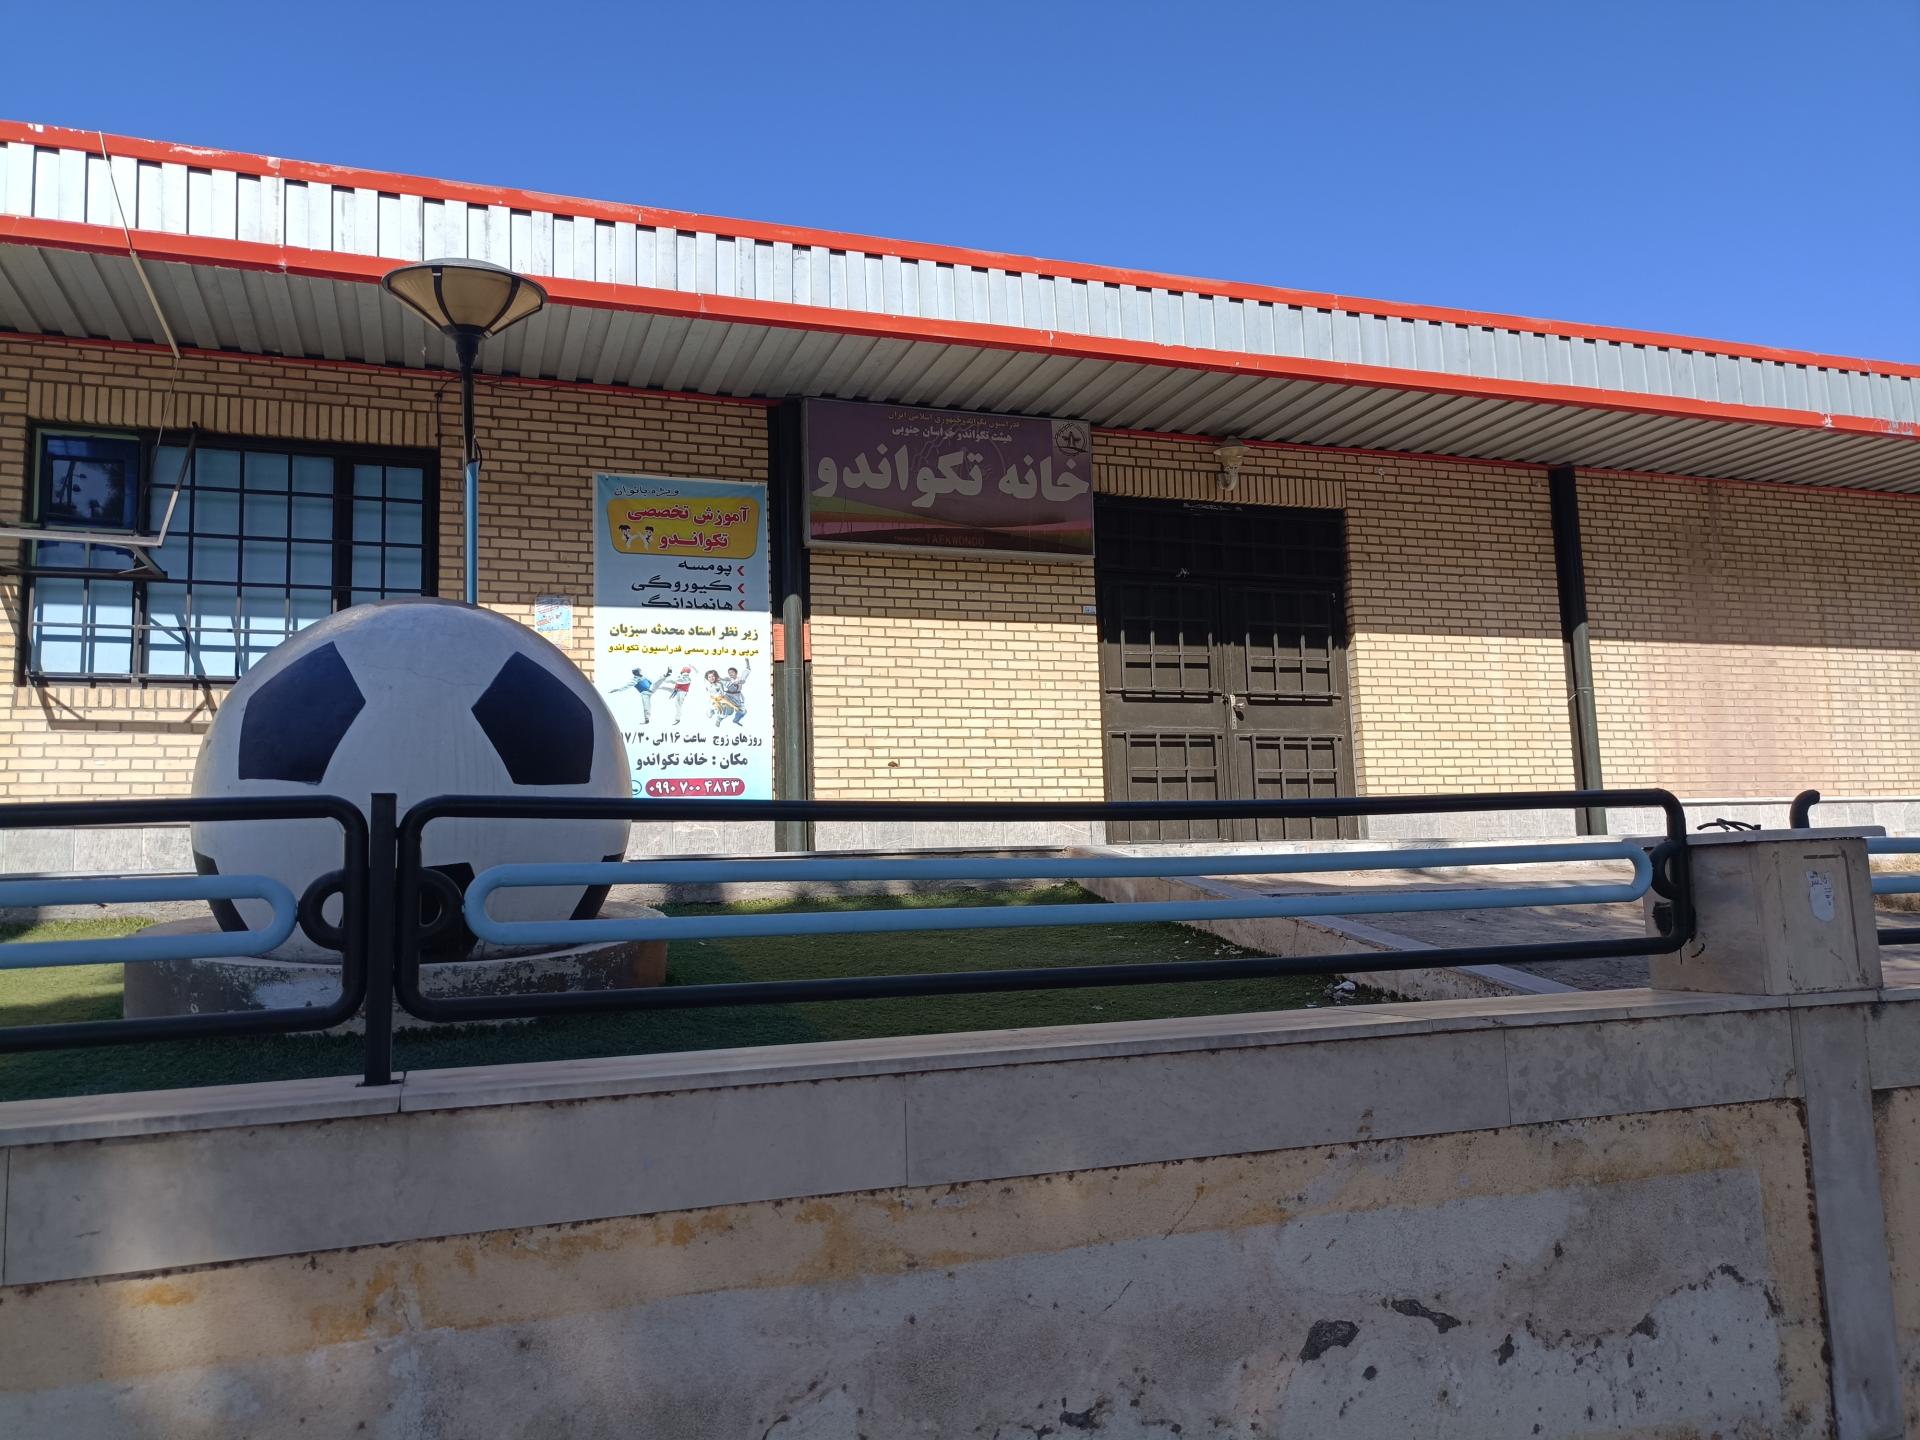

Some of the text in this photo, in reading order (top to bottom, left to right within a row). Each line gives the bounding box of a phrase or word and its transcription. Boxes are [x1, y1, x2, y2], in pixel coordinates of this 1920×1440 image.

[892, 425, 920, 436] جنوبی
[922, 425, 956, 440] خراسان
[957, 429, 990, 442] تکواندو
[812, 443, 1090, 508] خانه تکواندو
[614, 485, 680, 497] ویژه بانوان
[627, 505, 750, 526] آموزش تخصصی
[659, 531, 729, 551] تکواندو
[678, 560, 733, 576] پومسه
[631, 574, 733, 594] کیوروگی
[642, 594, 733, 611] هانمادانگ
[651, 624, 685, 636] محدثه
[688, 625, 716, 637] استاد
[719, 626, 738, 640] نظر
[741, 628, 759, 640] زیر
[608, 643, 639, 653] تکواندو
[641, 644, 682, 655] فدراسیون
[684, 647, 709, 655] رسمی
[731, 648, 737, 656] و
[739, 648, 759, 656] مربی
[652, 732, 668, 746] الی
[670, 732, 681, 744] ۱۶
[683, 732, 707, 744] ساعت
[712, 733, 730, 746] زوج
[731, 732, 762, 746] روزهای
[635, 752, 680, 770] تکواندو
[682, 752, 708, 766] خانه
[720, 752, 749, 769] مکان
[649, 780, 740, 794] ۰۹۹۰ ۷۰۰ ۴۸۴۳
